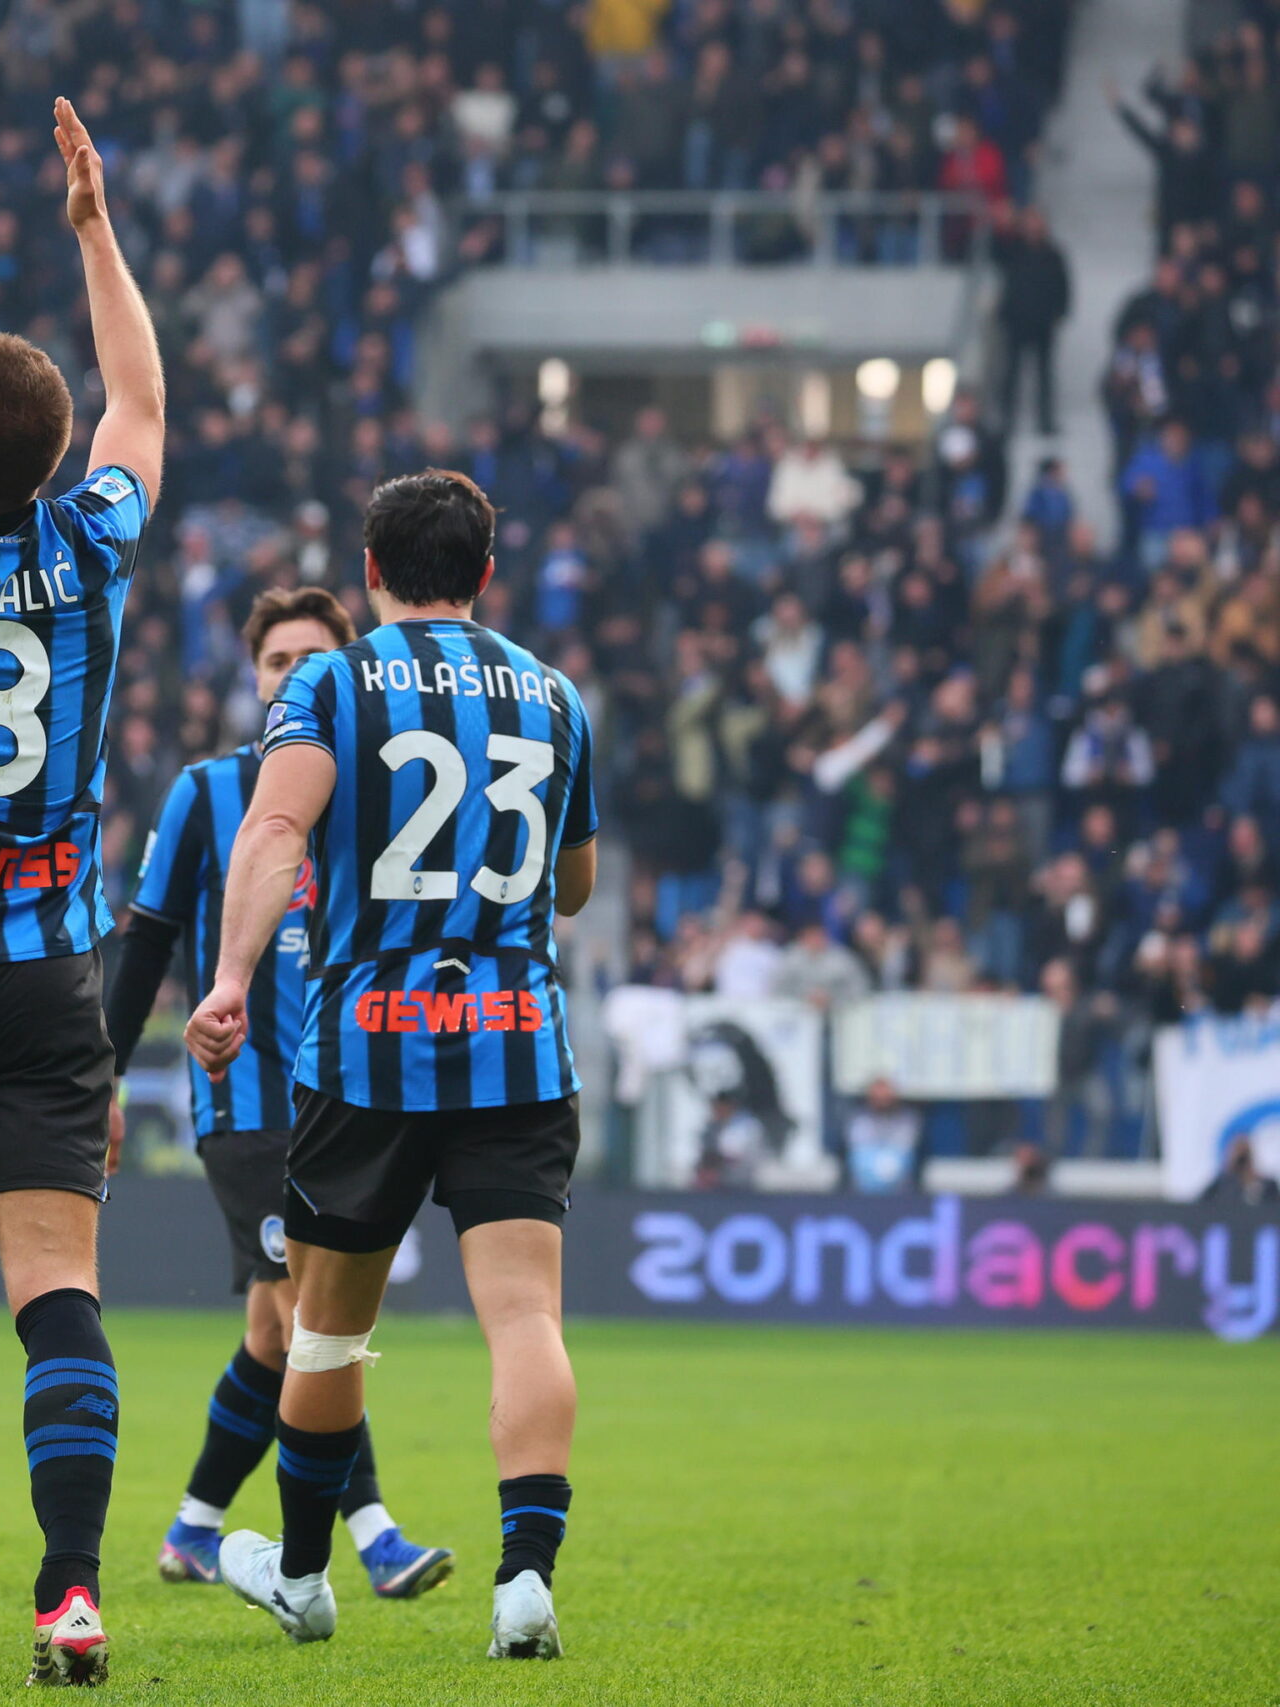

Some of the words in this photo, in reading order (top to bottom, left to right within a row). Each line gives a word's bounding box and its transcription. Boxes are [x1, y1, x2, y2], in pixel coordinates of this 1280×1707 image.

[361, 656, 562, 713] KOLAŠINAC
[370, 730, 555, 904] 23
[355, 990, 543, 1033] GEWISS
